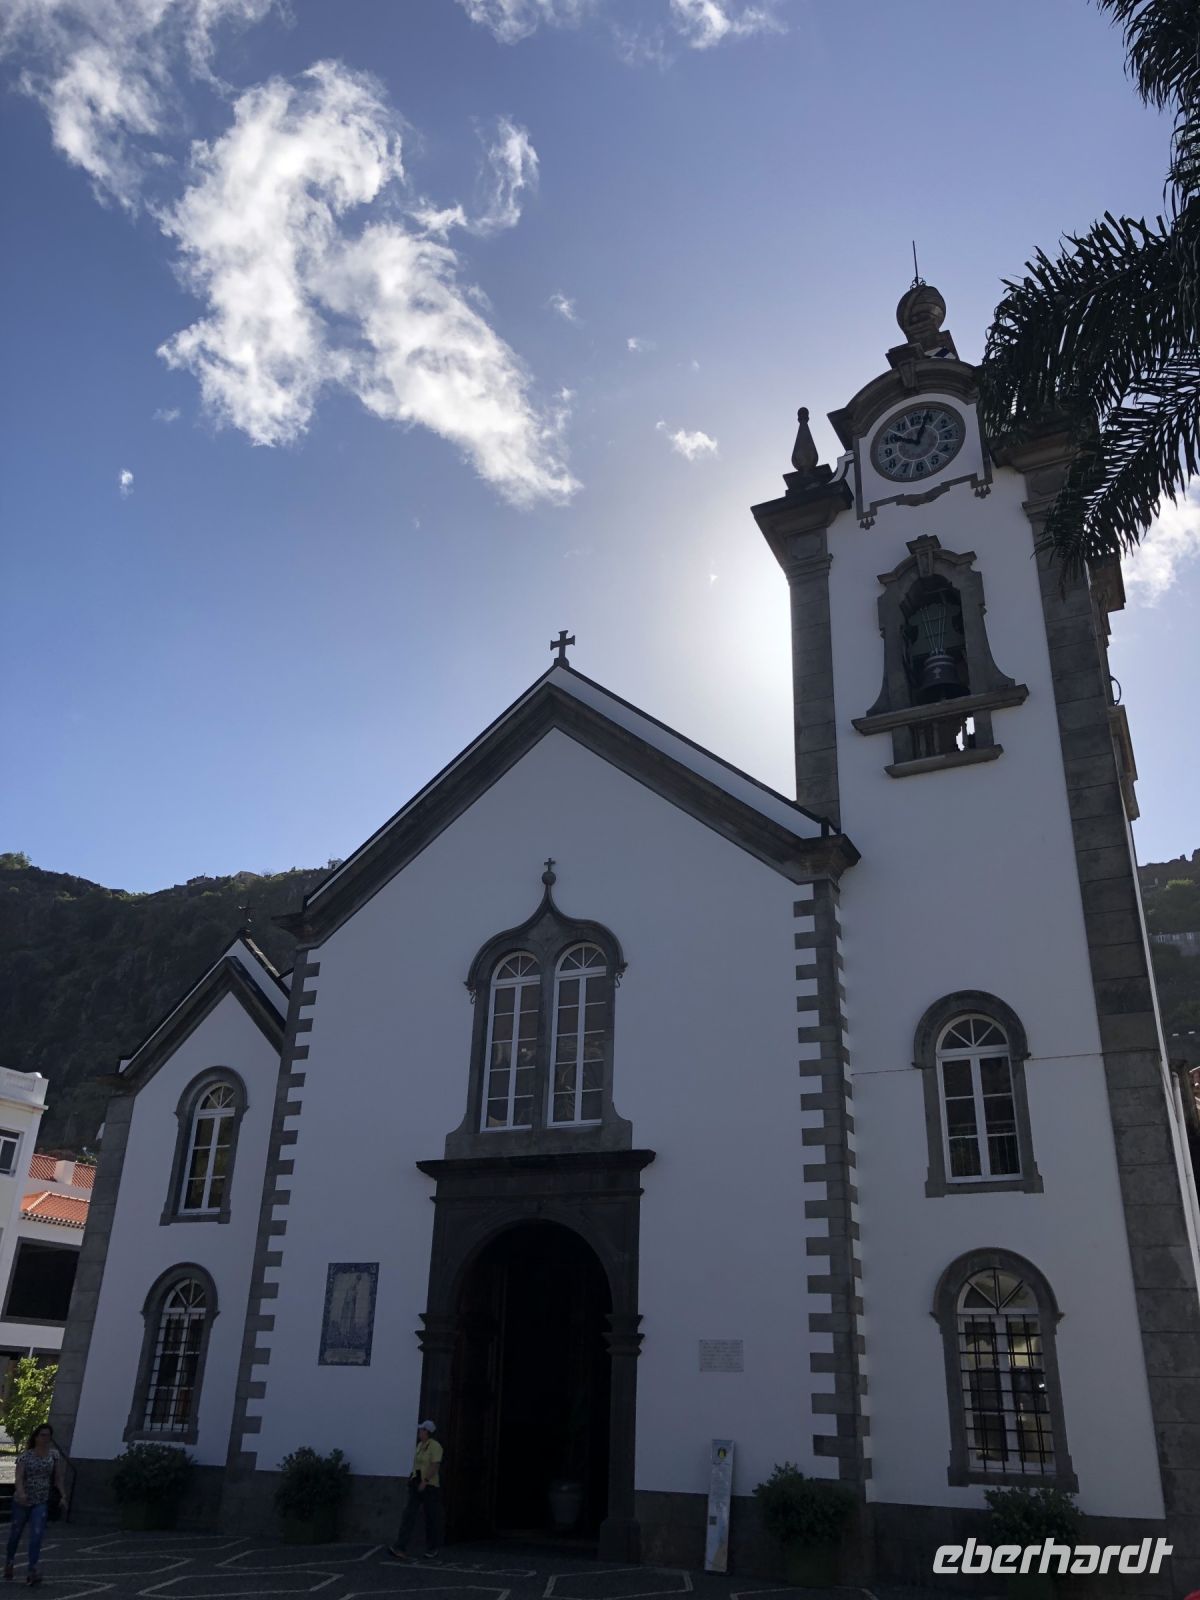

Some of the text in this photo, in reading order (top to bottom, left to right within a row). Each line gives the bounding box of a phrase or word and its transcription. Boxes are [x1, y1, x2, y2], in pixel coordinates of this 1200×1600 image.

[909, 415, 922, 426] 12
[941, 419, 948, 428] 2
[895, 422, 906, 432] 11
[884, 447, 893, 457] 9
[888, 458, 897, 469] 8
[931, 455, 940, 465] 5
[901, 463, 909, 473] 7
[916, 461, 924, 472] 6
